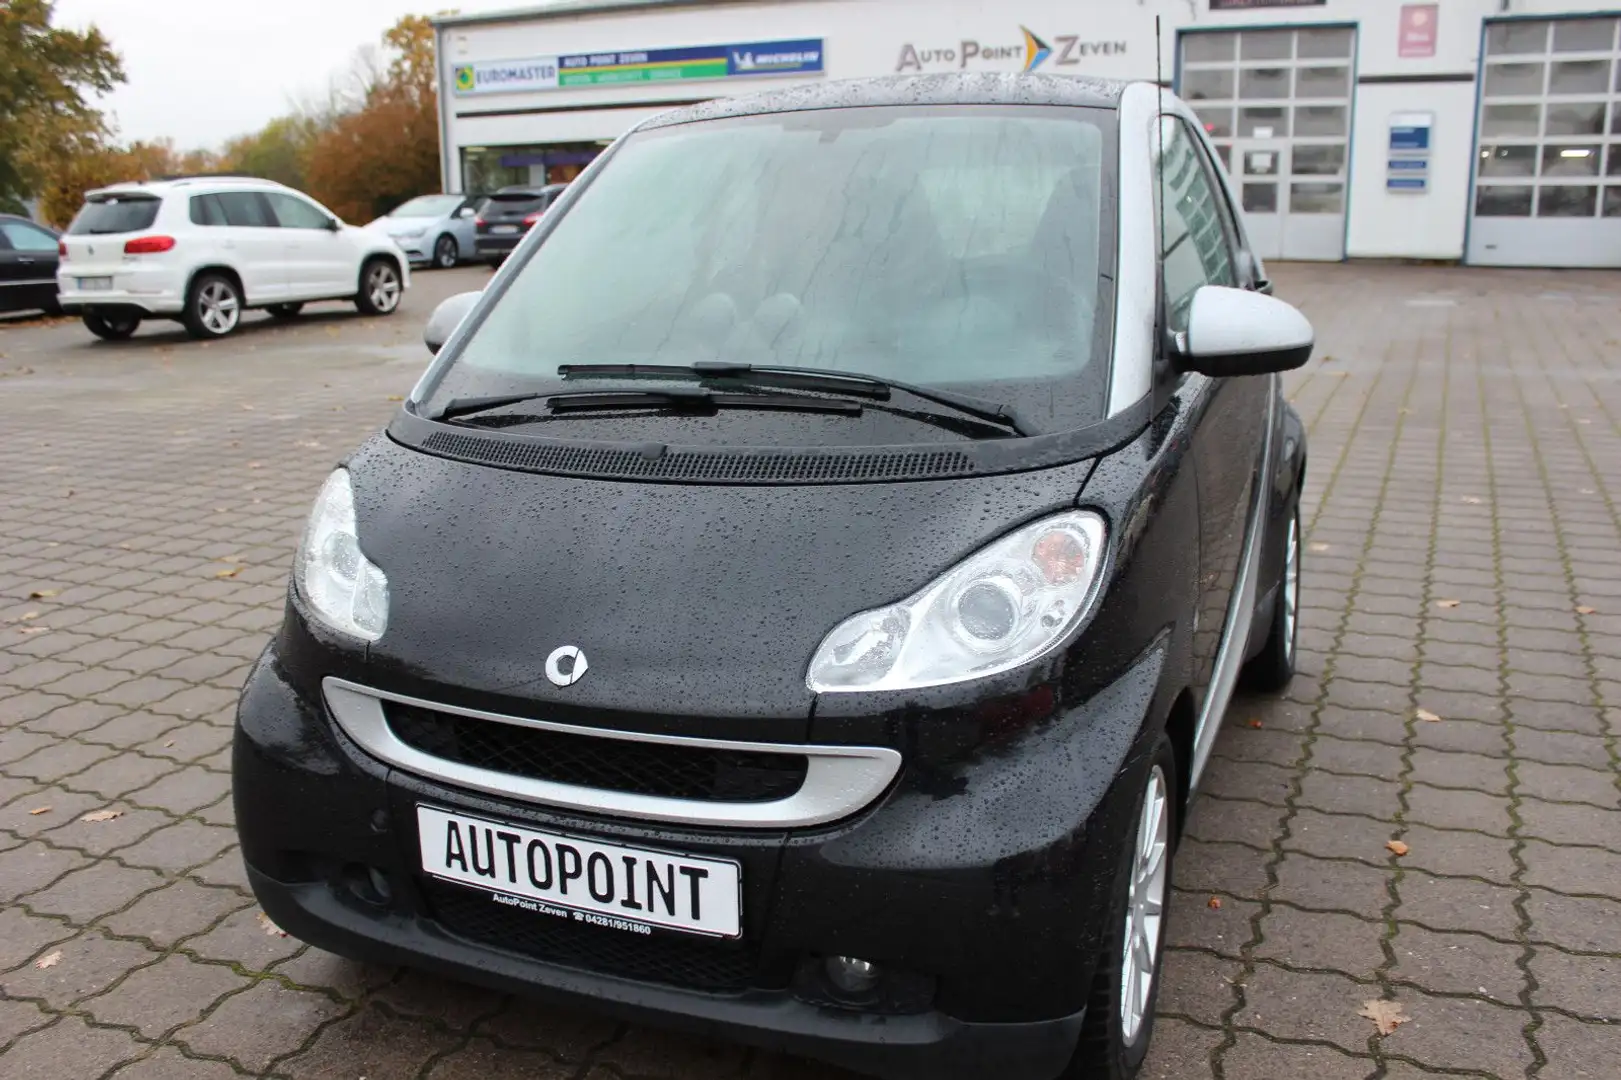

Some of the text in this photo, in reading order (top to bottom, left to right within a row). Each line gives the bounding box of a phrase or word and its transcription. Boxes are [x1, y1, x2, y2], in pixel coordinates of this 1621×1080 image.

[895, 35, 1127, 72] AUTO POINT ZEVEN
[476, 66, 555, 84] EUROMASTER
[445, 820, 709, 921] AUTOPOINT
[493, 893, 651, 935] AutoPoint Zeven 04281/951860
